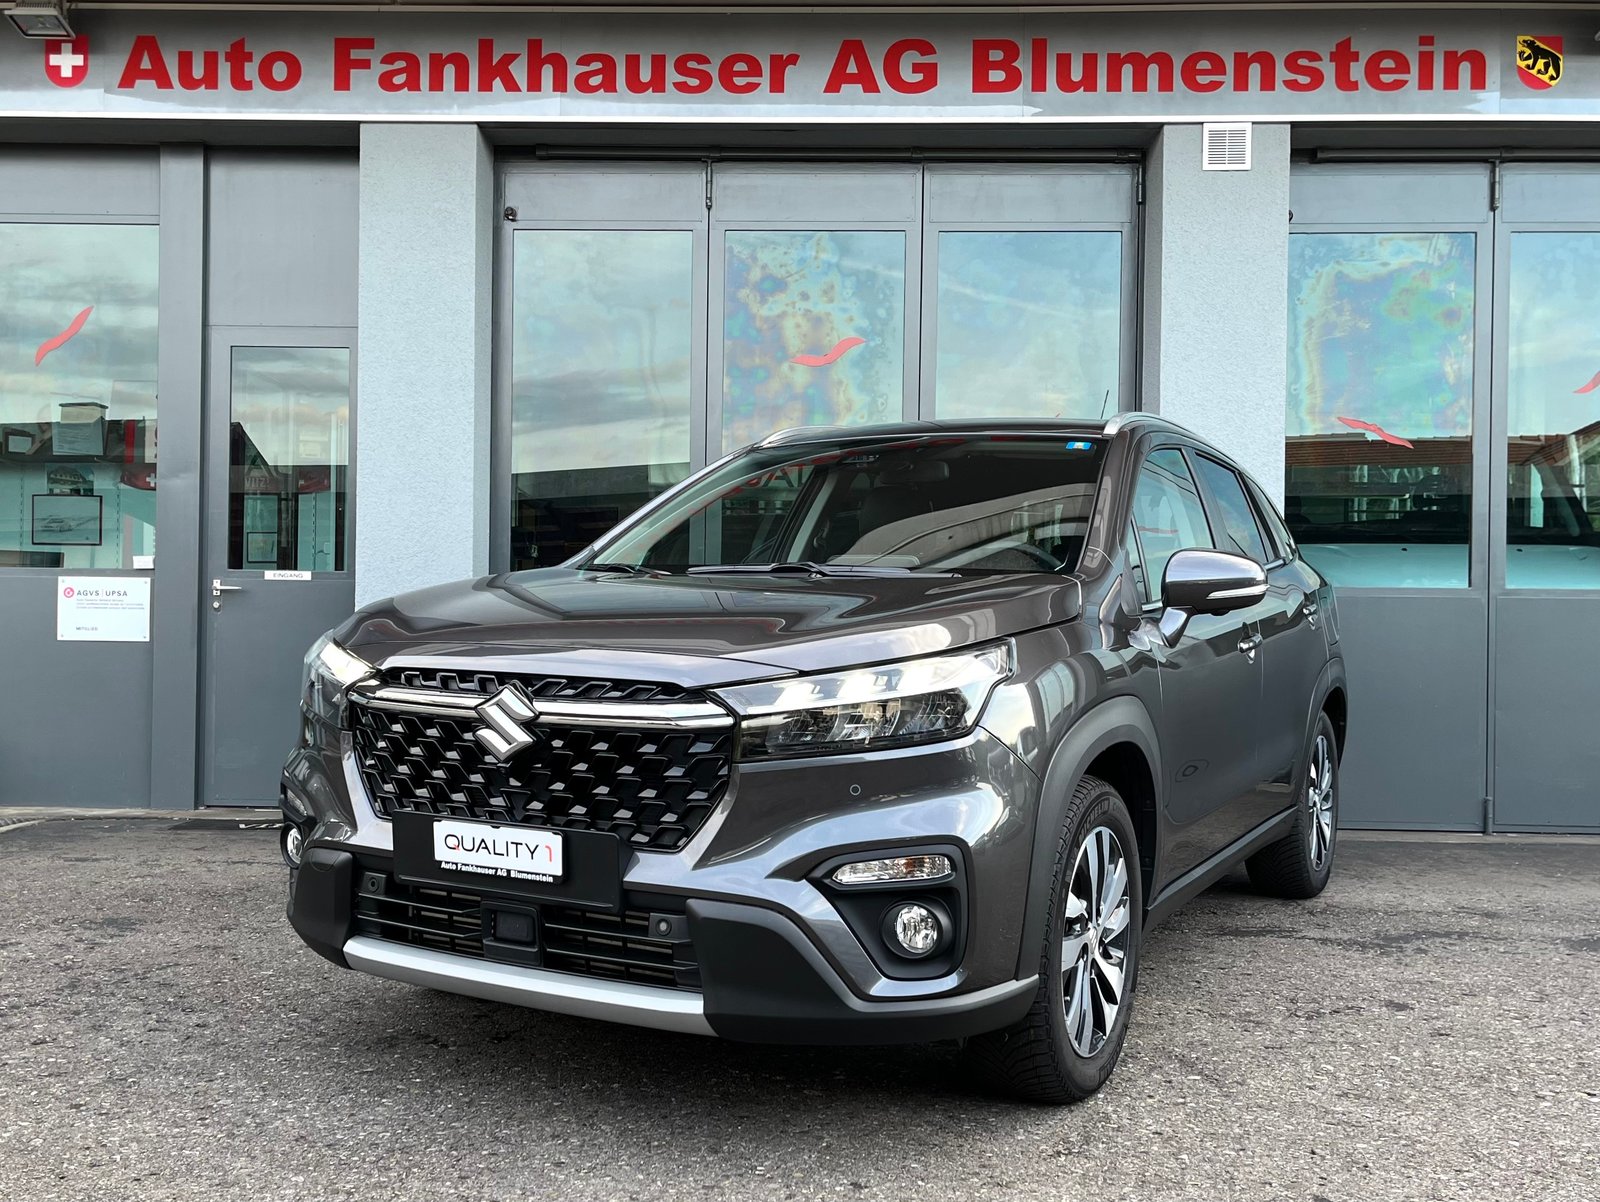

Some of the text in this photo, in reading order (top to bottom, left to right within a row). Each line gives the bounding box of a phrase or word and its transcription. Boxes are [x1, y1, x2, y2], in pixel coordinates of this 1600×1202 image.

[117, 34, 1488, 94] Auto Fankhauser AG Blumenstein
[76, 589, 128, 597] AGVS UPSA
[444, 833, 553, 863] QUALITY 1
[440, 860, 554, 883] Auto Fankhauser AG Blumenstein
